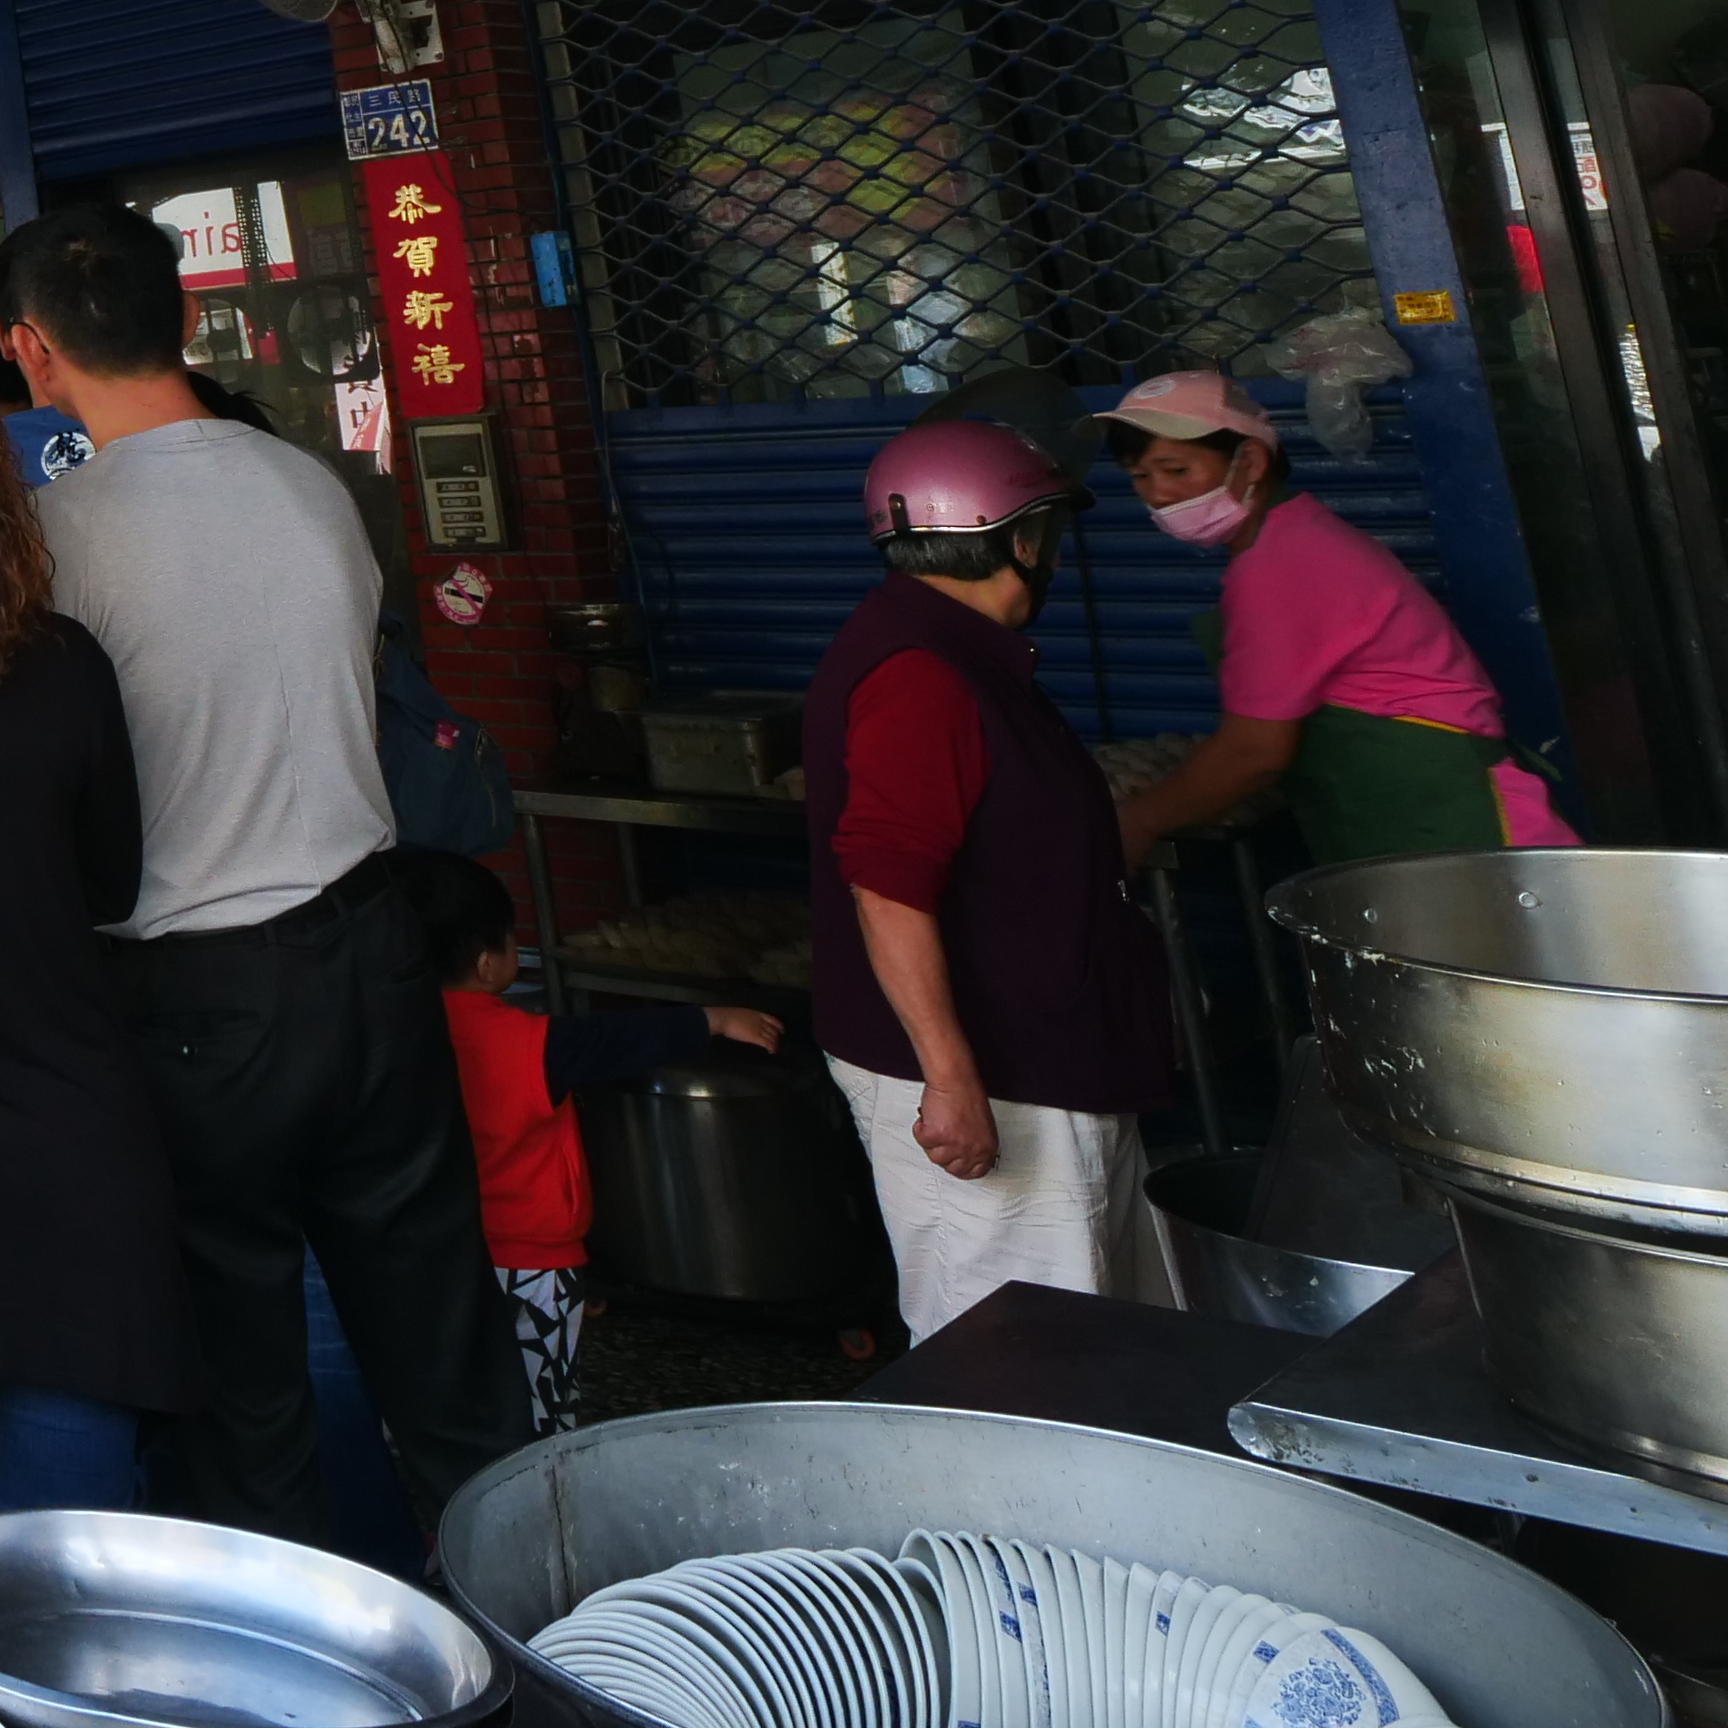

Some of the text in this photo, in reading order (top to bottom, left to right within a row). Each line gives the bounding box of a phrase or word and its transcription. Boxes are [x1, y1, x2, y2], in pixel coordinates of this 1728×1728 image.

[368, 110, 431, 152] 242
[388, 182, 466, 386] 恭賀新禧
